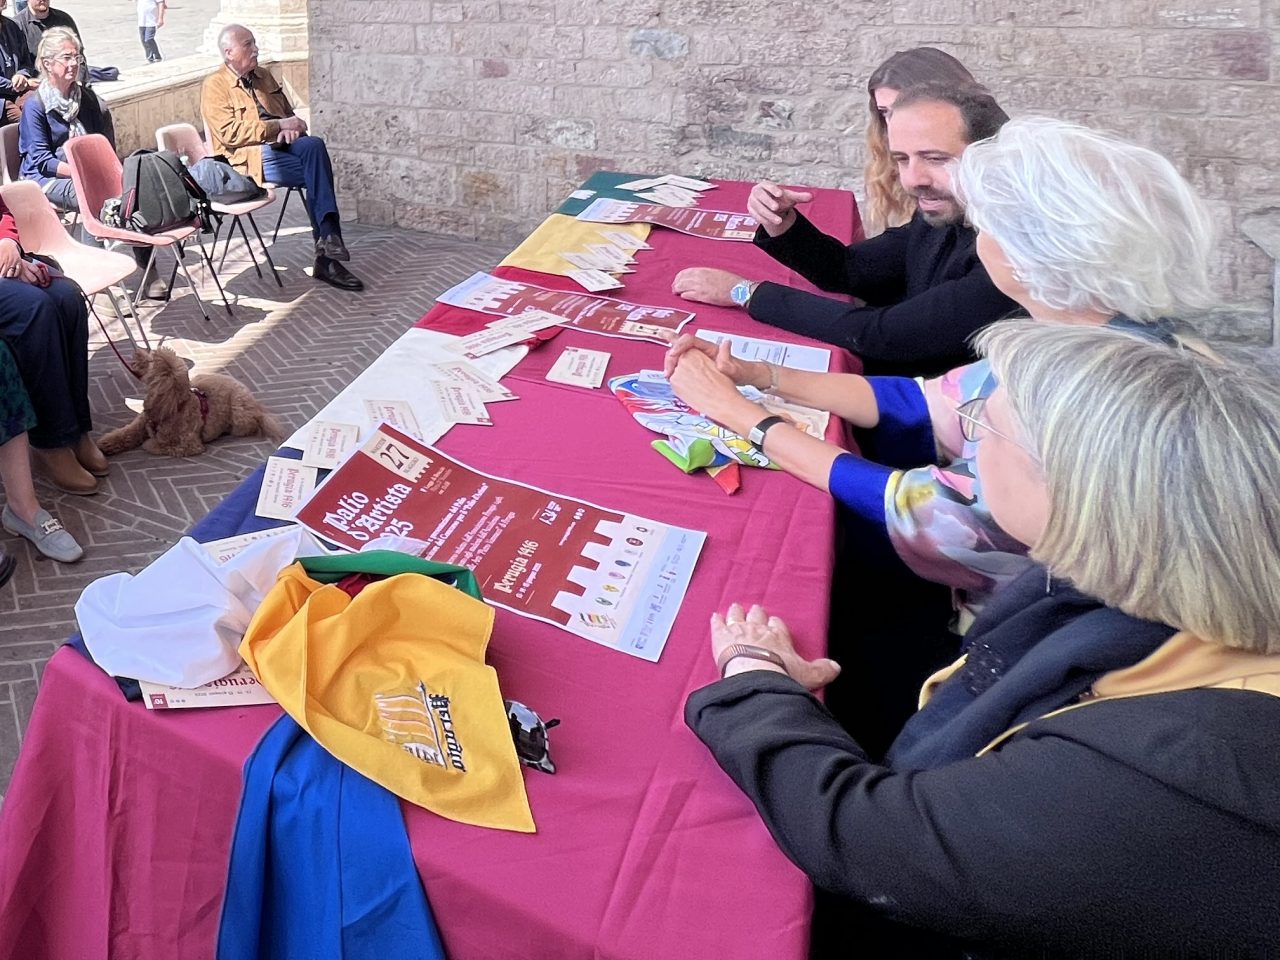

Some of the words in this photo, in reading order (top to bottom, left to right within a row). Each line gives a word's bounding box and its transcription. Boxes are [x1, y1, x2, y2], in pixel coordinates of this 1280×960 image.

[379, 443, 410, 470] 27
[322, 491, 369, 533] Palio
[346, 483, 413, 541] d'Artista
[492, 557, 528, 594] Perugia
[517, 538, 539, 557] 1416
